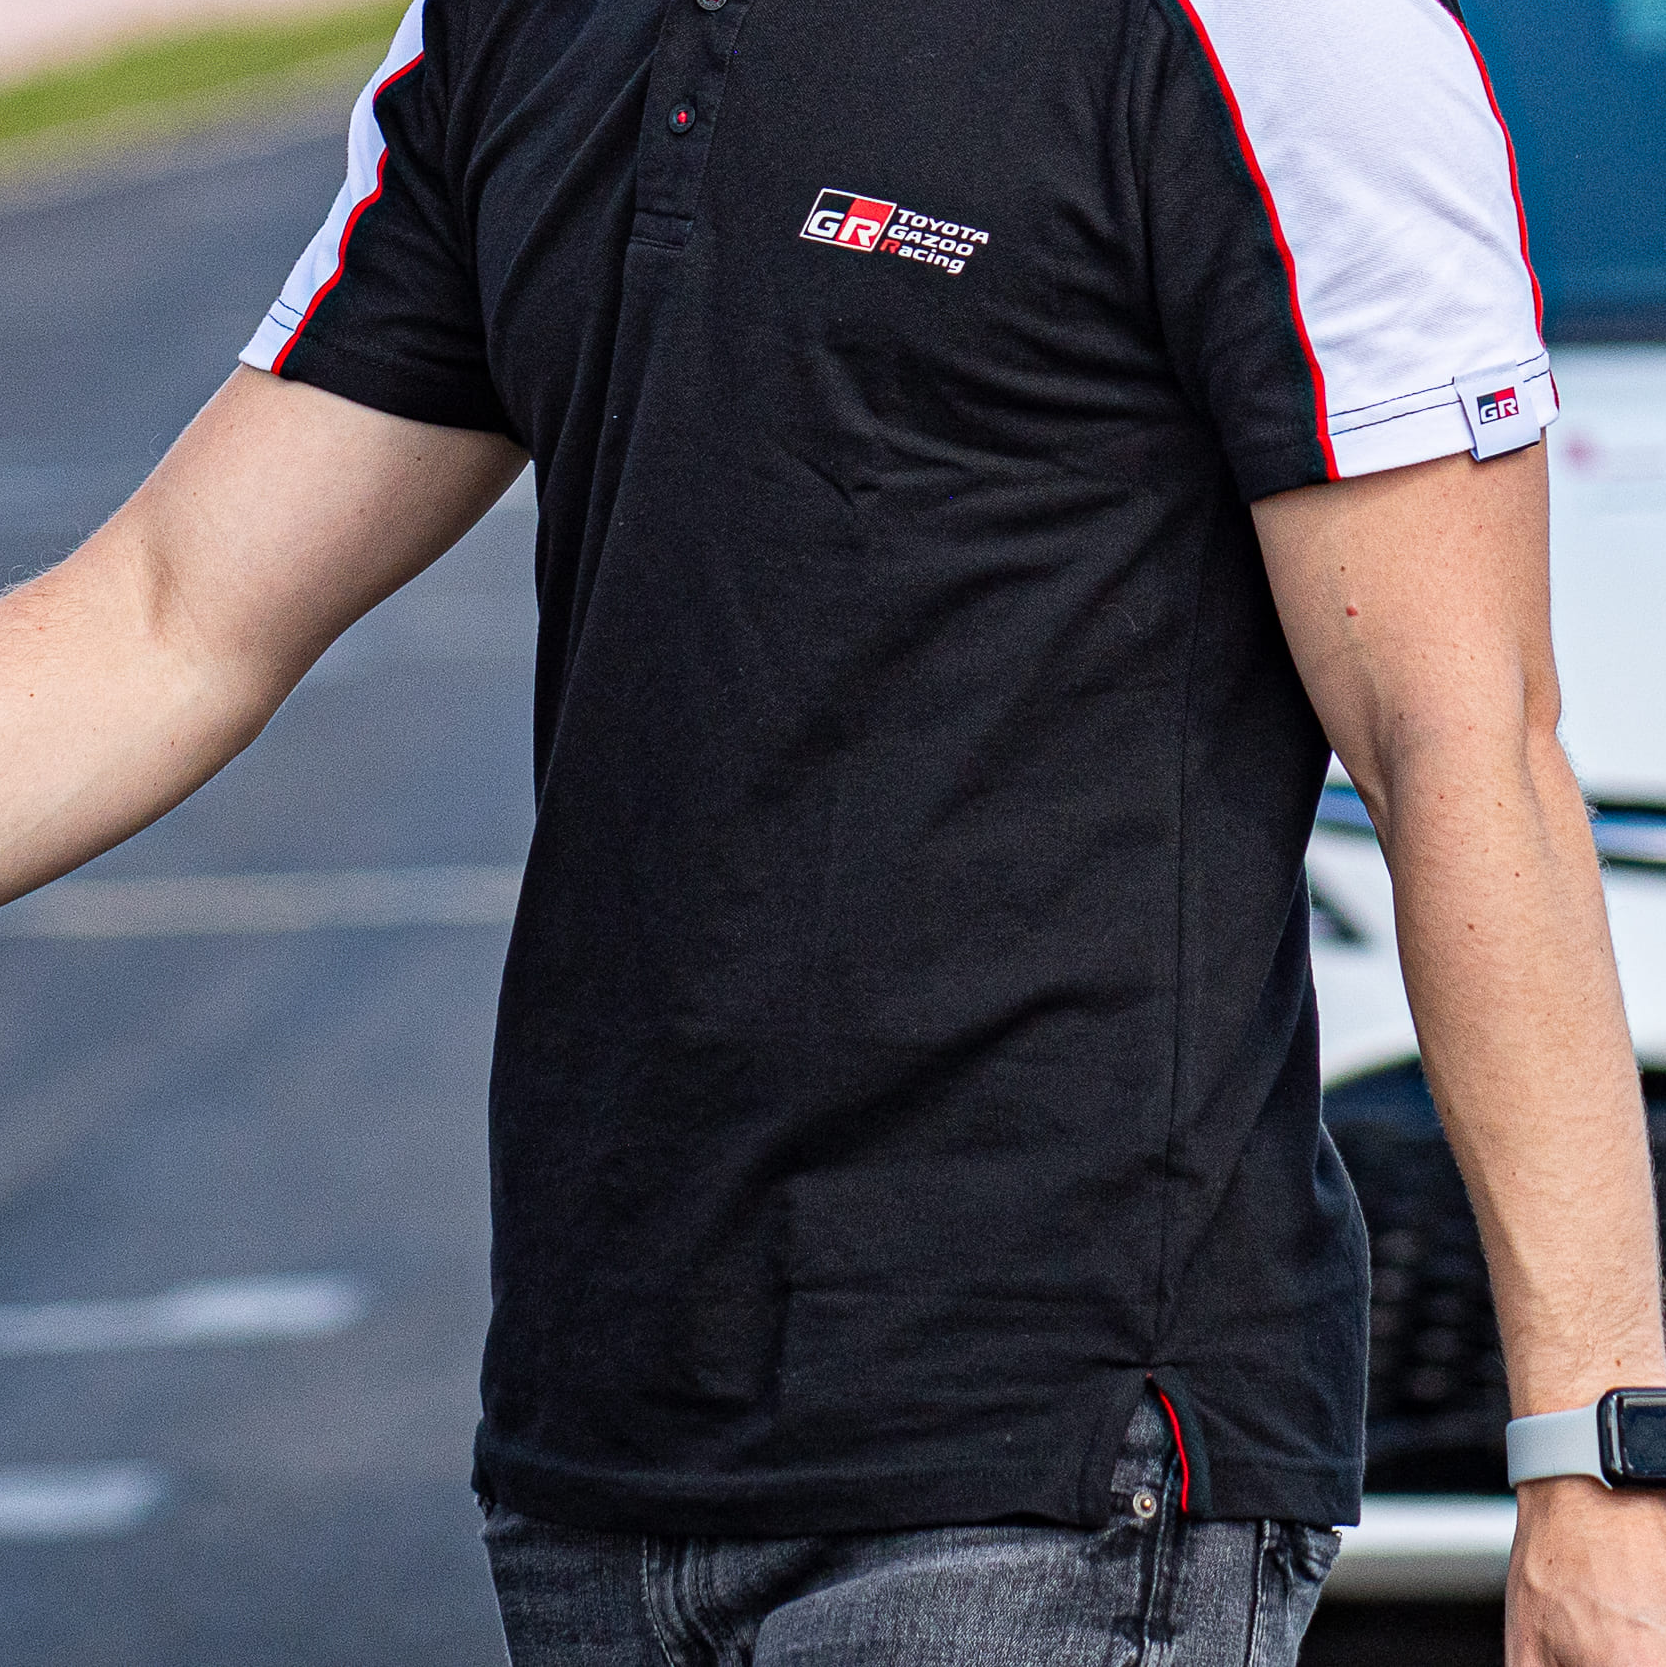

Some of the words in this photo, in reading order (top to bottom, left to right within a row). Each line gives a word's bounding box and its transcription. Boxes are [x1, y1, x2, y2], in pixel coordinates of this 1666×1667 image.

[807, 210, 881, 247] GR
[887, 224, 974, 256] GAZOO
[897, 209, 990, 245] TOYOTA
[879, 238, 966, 274] Racing
[1480, 397, 1517, 423] GR
